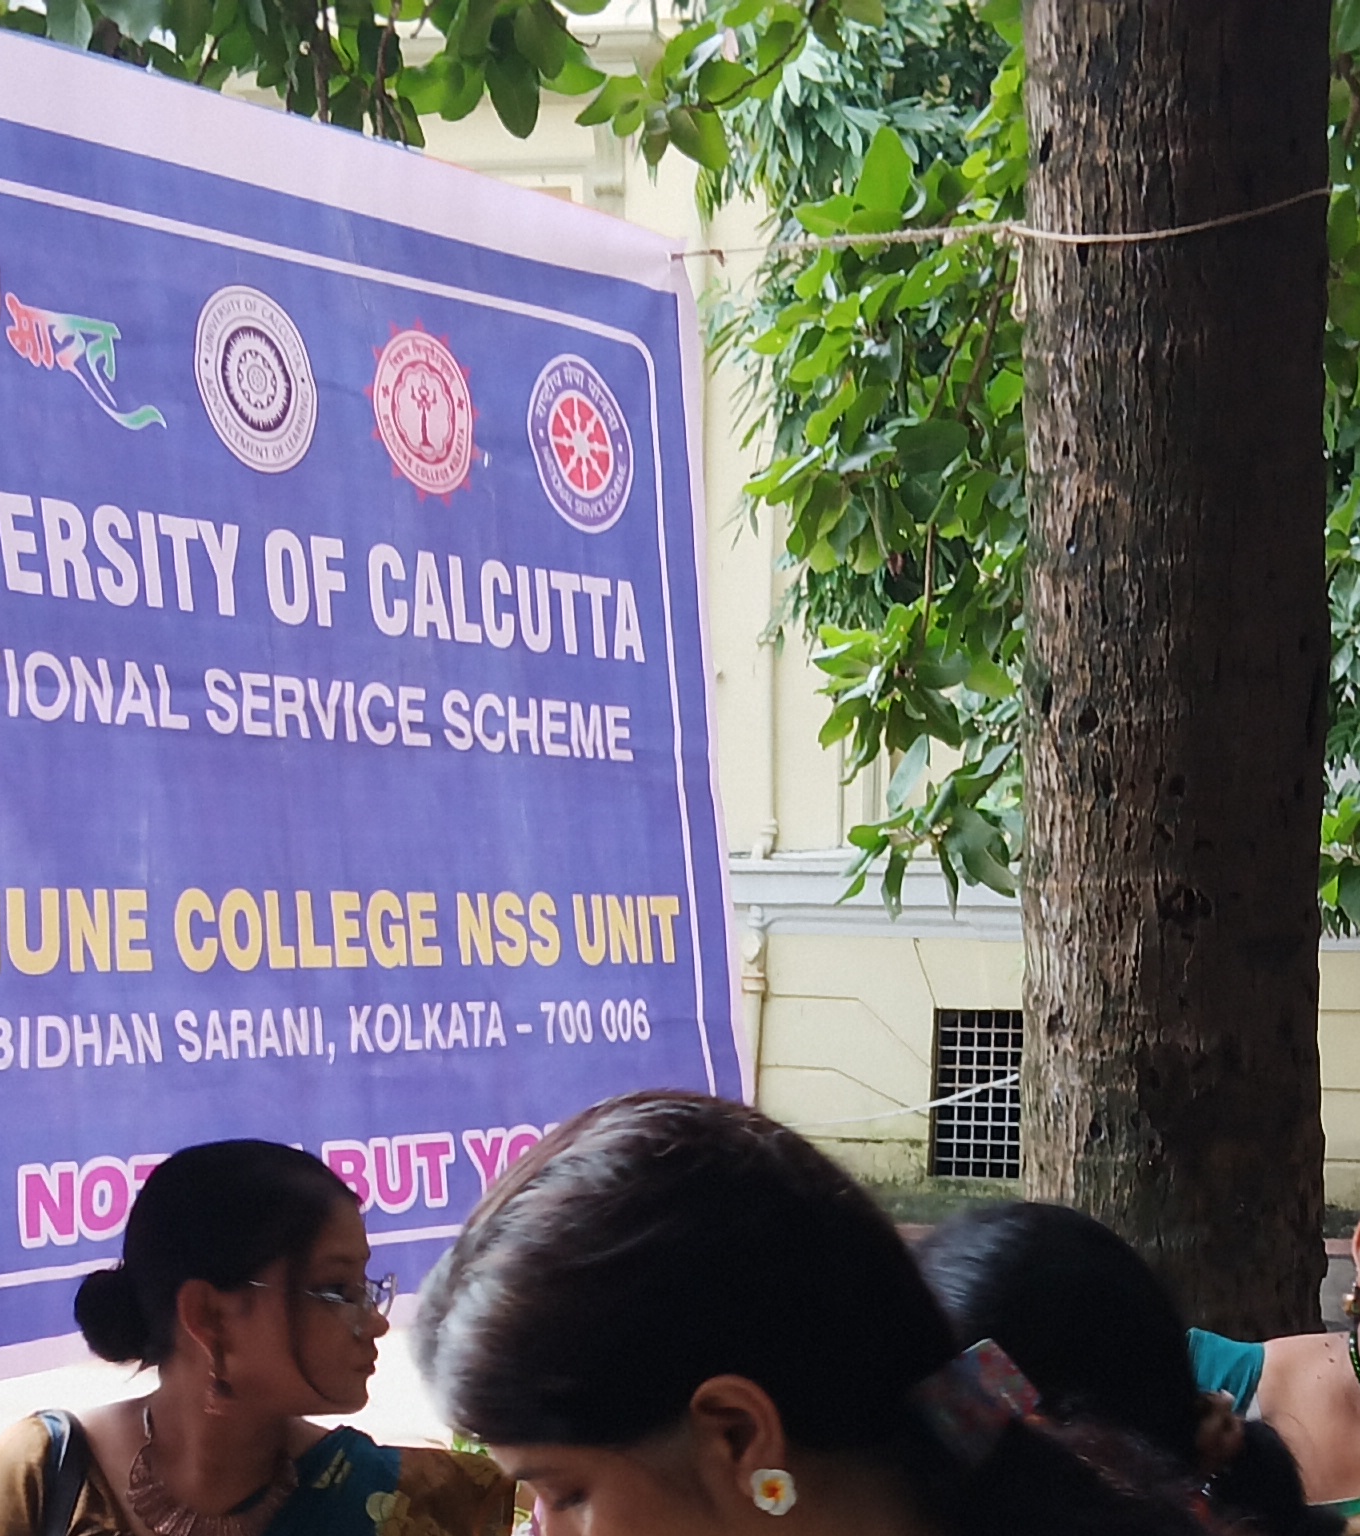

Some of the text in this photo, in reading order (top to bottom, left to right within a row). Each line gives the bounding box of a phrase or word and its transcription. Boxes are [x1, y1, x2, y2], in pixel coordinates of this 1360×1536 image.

[264, 528, 346, 627] OF
[368, 543, 645, 663] CALCUTTA
[204, 668, 432, 747] SERVICE
[442, 689, 634, 761] SCHEME
[174, 888, 442, 973] COLLEGE
[456, 891, 561, 967] NSS
[572, 894, 680, 964] UNIT
[174, 1007, 336, 1065] SARANI,
[349, 1001, 507, 1054] KOLKATA
[539, 1000, 594, 1044] 700
[601, 998, 652, 1043] 006
[322, 1132, 455, 1214] BUT
